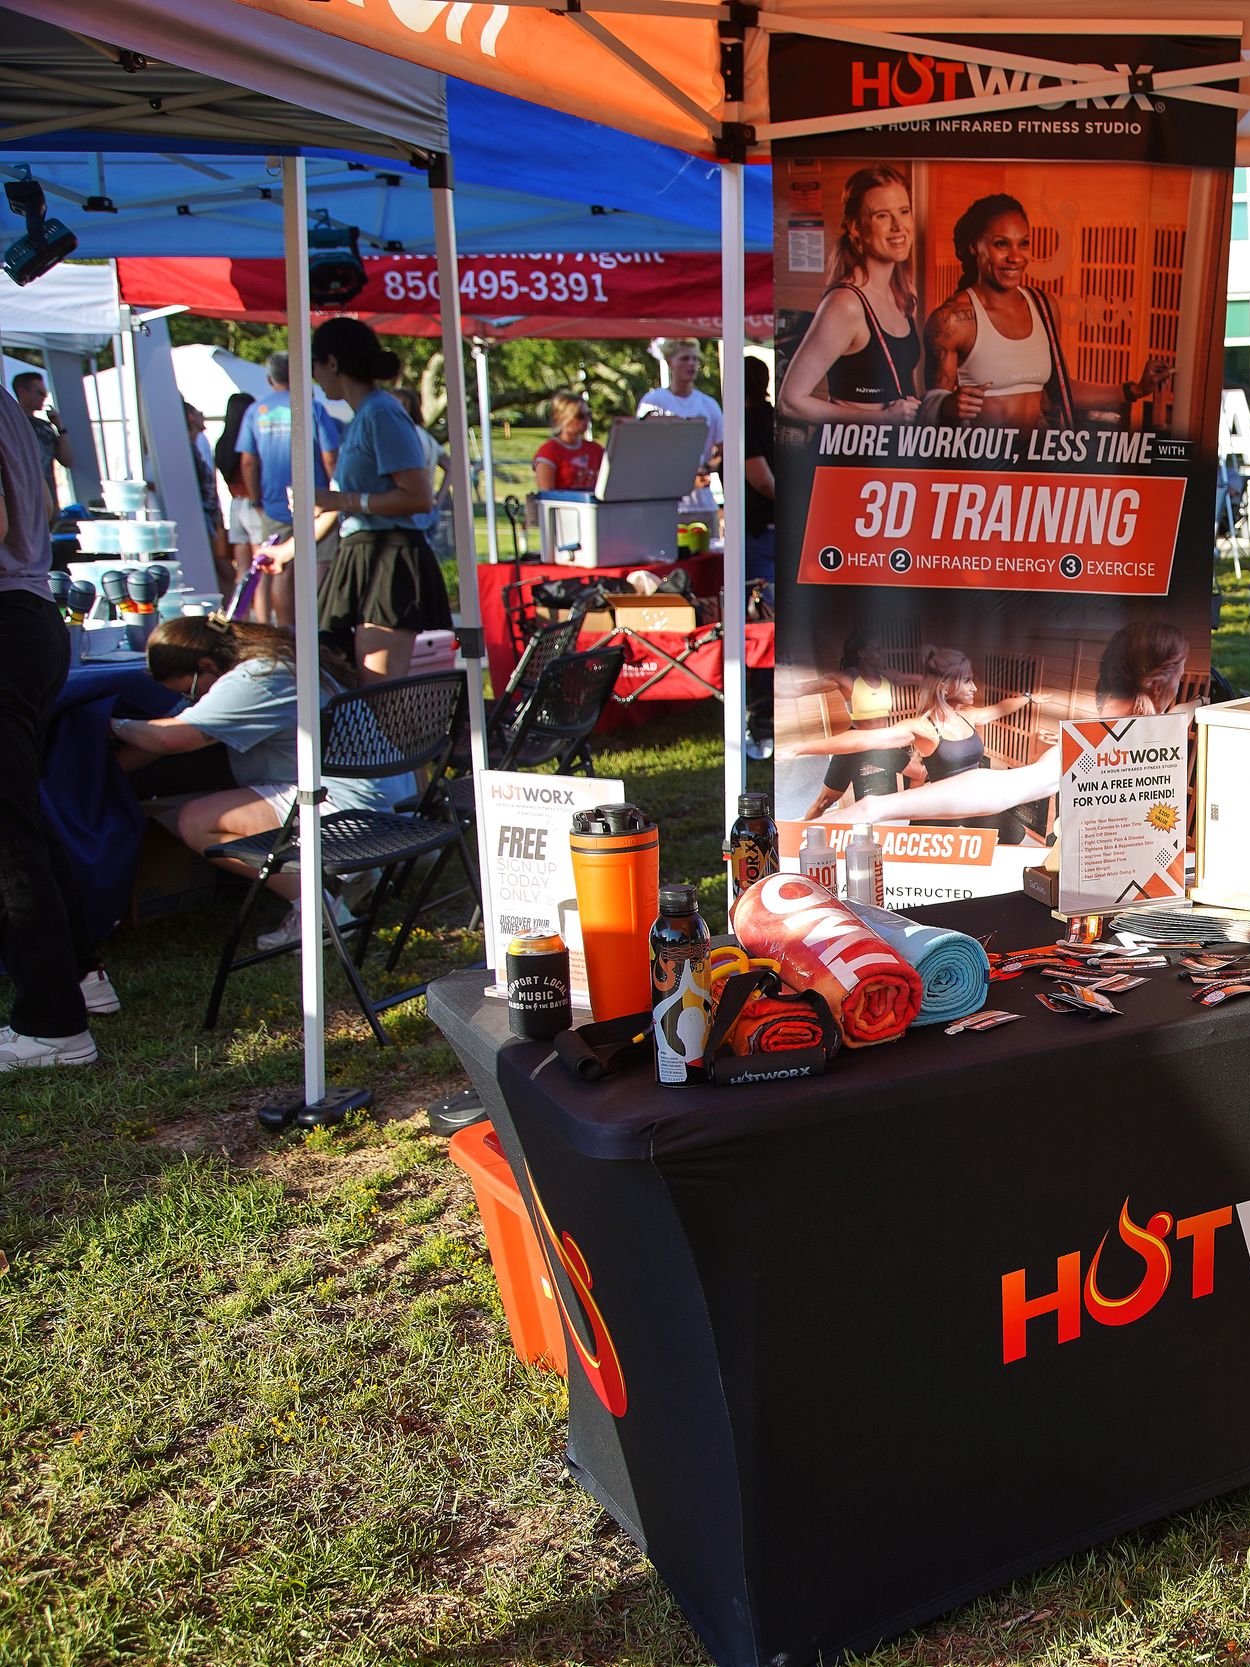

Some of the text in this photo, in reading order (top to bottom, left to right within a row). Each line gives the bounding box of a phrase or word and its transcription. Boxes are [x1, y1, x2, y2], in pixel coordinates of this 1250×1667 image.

[889, 121, 931, 133] HOUR
[936, 120, 1012, 133] INFRARED
[1018, 121, 1080, 134] FITNESS
[1085, 122, 1142, 135] STUDIO
[819, 423, 1185, 464] MORE WORKOUT, LESS TIME WITH
[854, 480, 1141, 547] 3D TRAINING
[847, 552, 886, 567] HEAT
[916, 556, 992, 571] INFRARED
[996, 558, 1056, 573] ENERGY
[1087, 561, 1155, 577] EXERCISE
[1097, 747, 1181, 768] HOTWORX
[1077, 775, 1171, 792] WIN A FREE MONTH
[491, 783, 575, 806] HOTWORX
[1073, 788, 1175, 808] FOR YOU & A FRIEND!
[497, 825, 548, 861] FREE
[883, 831, 955, 857] ACCESS
[959, 834, 983, 859] TO
[497, 857, 557, 875] SIGN UP
[498, 872, 550, 889] TODAY
[499, 887, 540, 903] ONLY
[499, 914, 532, 928] DISCOVER
[508, 975, 568, 999] SUPPORT LOCAL
[518, 990, 554, 1001] MUSIC
[730, 1066, 811, 1085] HOTWORX
